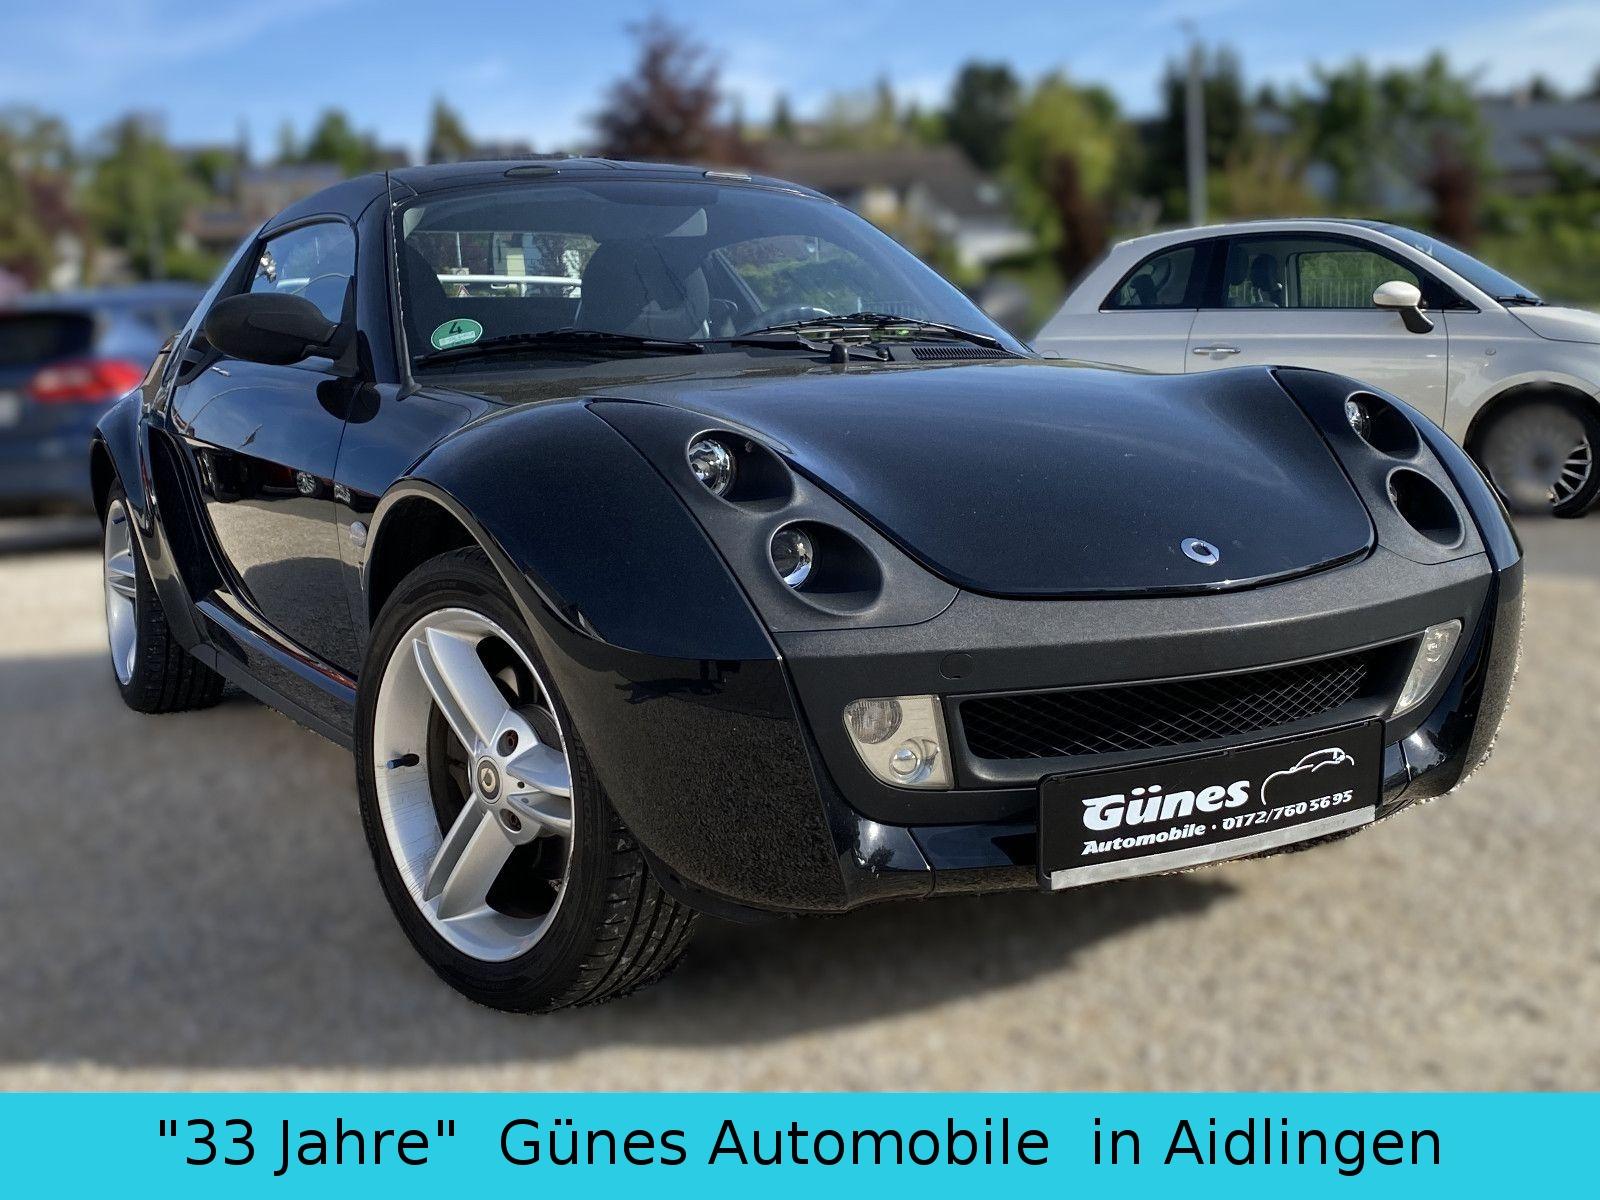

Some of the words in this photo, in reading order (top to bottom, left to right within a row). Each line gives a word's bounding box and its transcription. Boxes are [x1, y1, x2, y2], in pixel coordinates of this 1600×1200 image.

[448, 321, 463, 334] 4
[1081, 780, 1251, 831] Günes
[1081, 822, 1207, 856] Automobile
